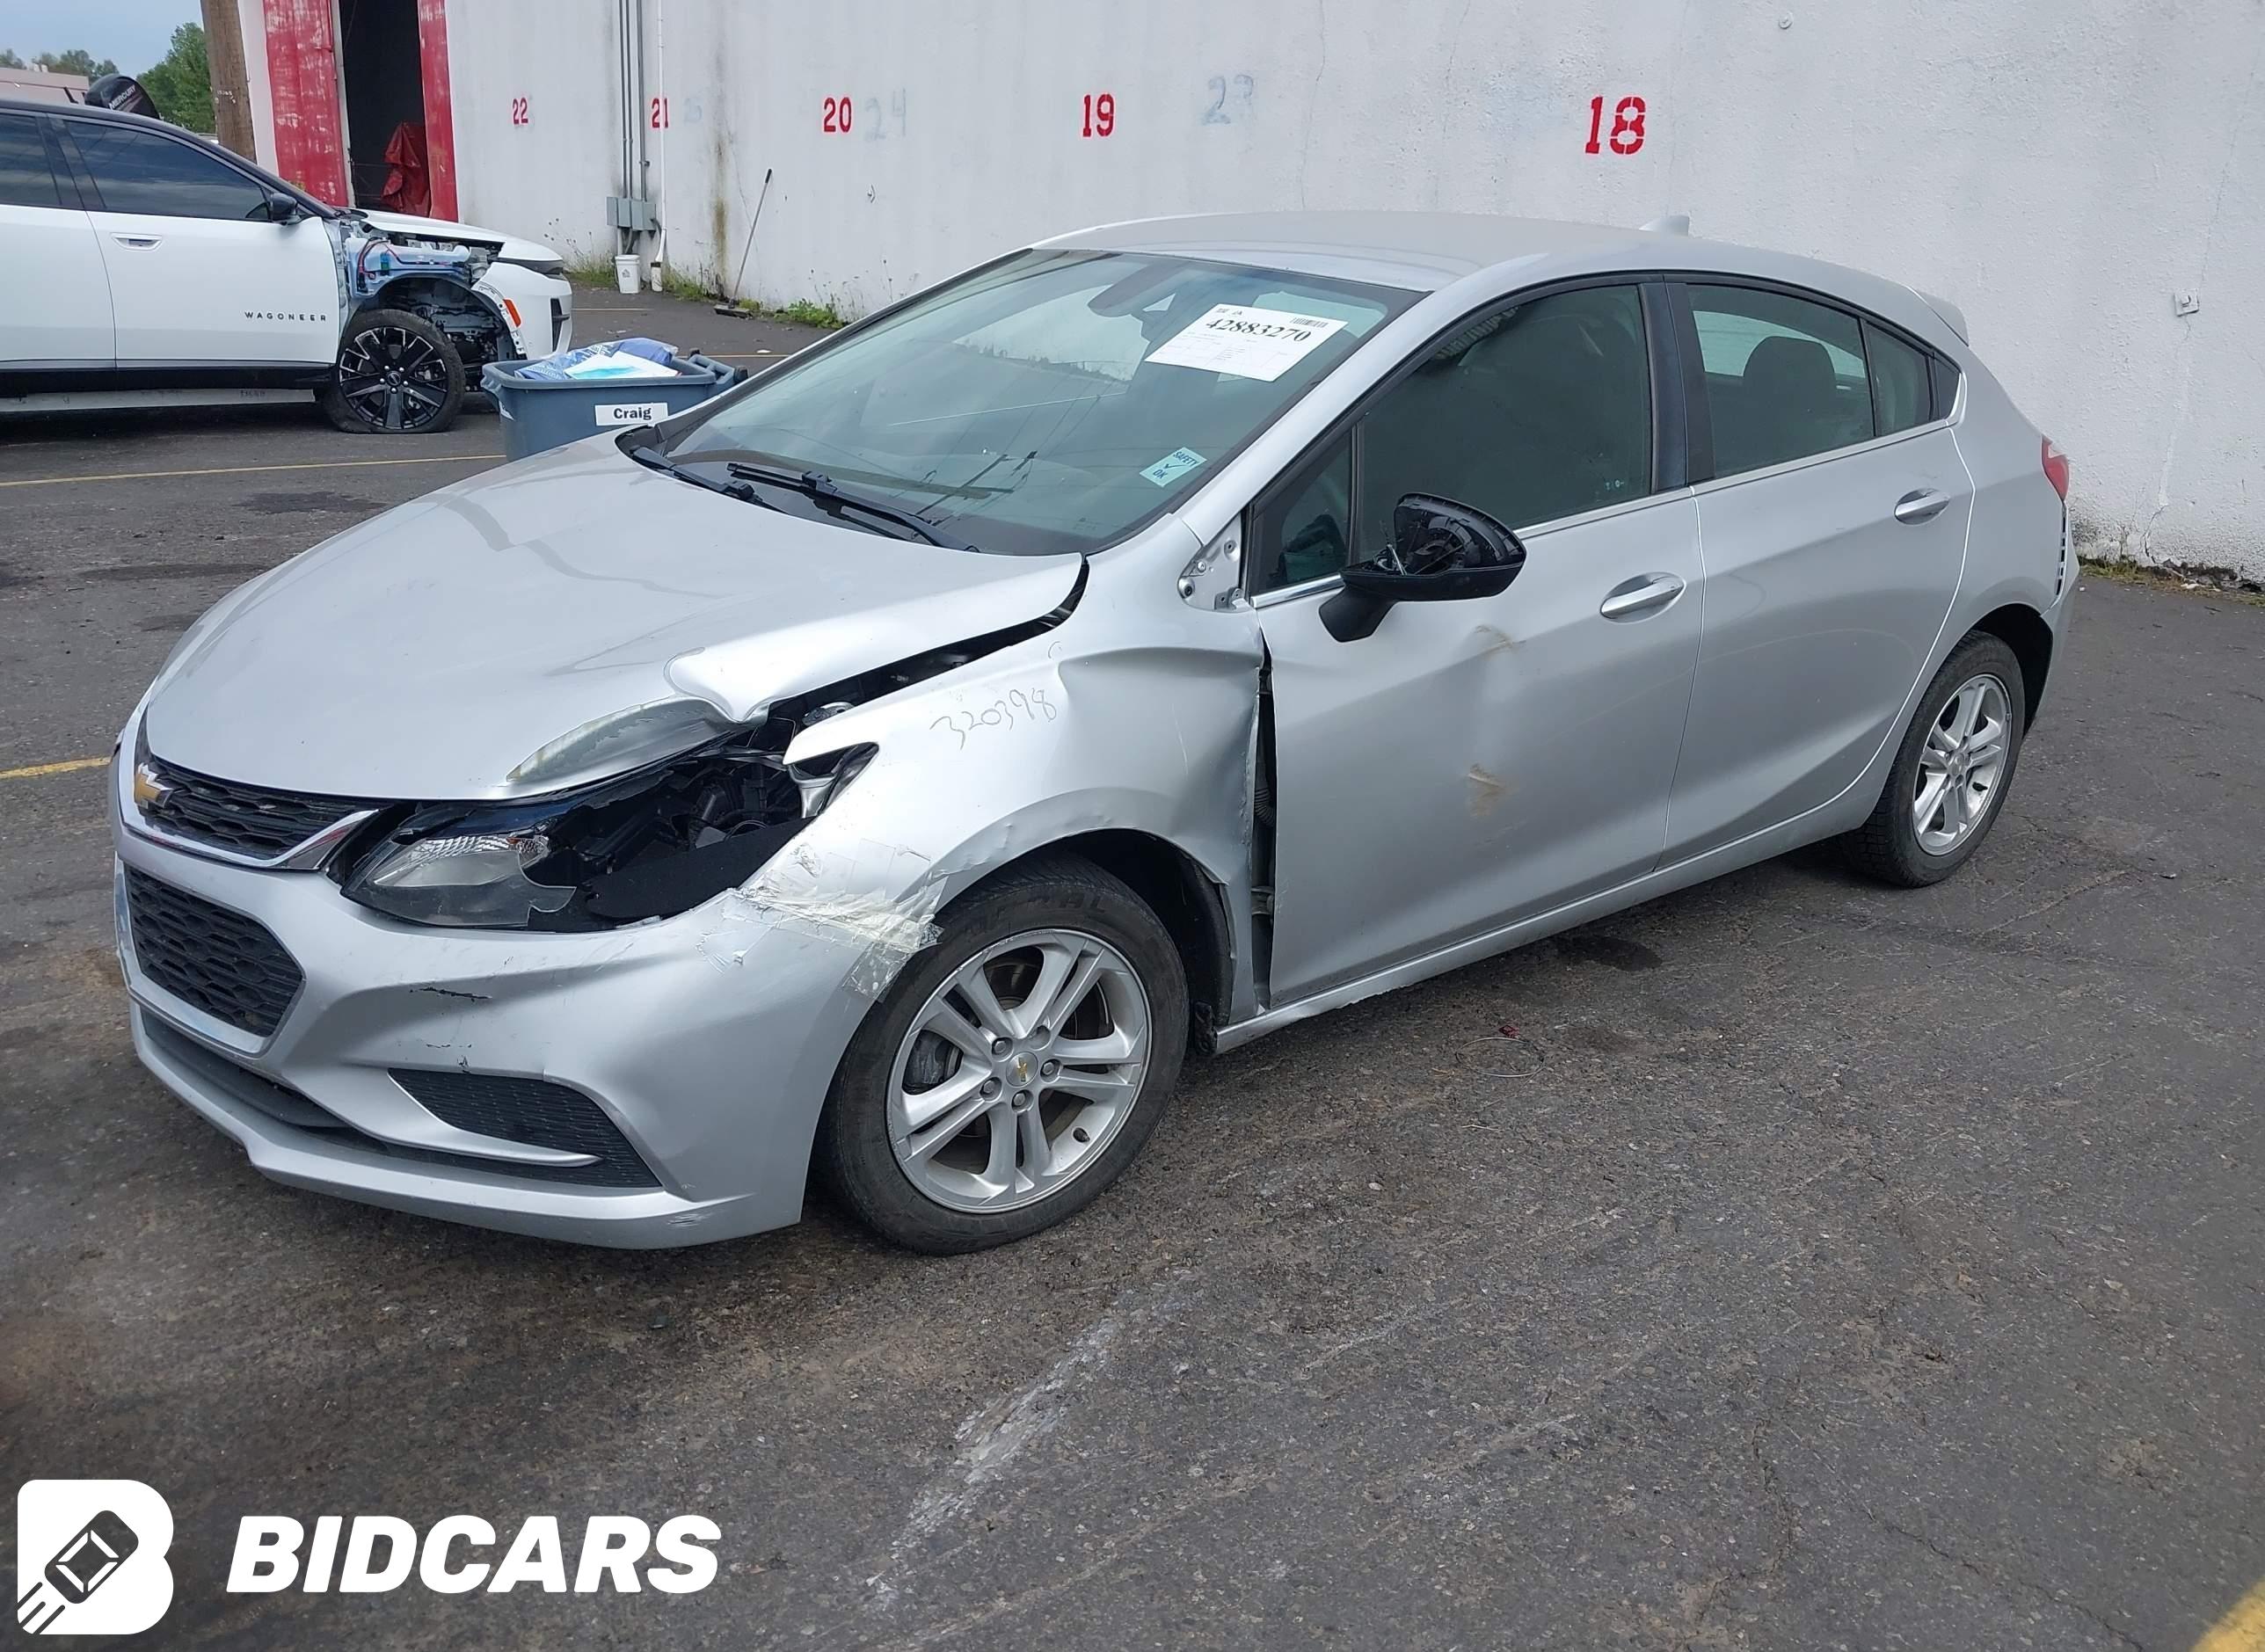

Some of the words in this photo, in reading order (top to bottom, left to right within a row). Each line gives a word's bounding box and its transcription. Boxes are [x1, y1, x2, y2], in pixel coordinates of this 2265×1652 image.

[108, 84, 136, 111] MERCURY
[512, 98, 528, 125] 22
[652, 98, 668, 128] 21
[823, 97, 852, 133] 20
[1082, 93, 1115, 137] 19
[1585, 96, 1646, 155] 18
[244, 311, 326, 322] WAGONEER
[1205, 317, 1312, 343] 42883270
[613, 406, 652, 421] Craig
[1173, 450, 1198, 467] SAFETY
[1153, 469, 1168, 479] OK
